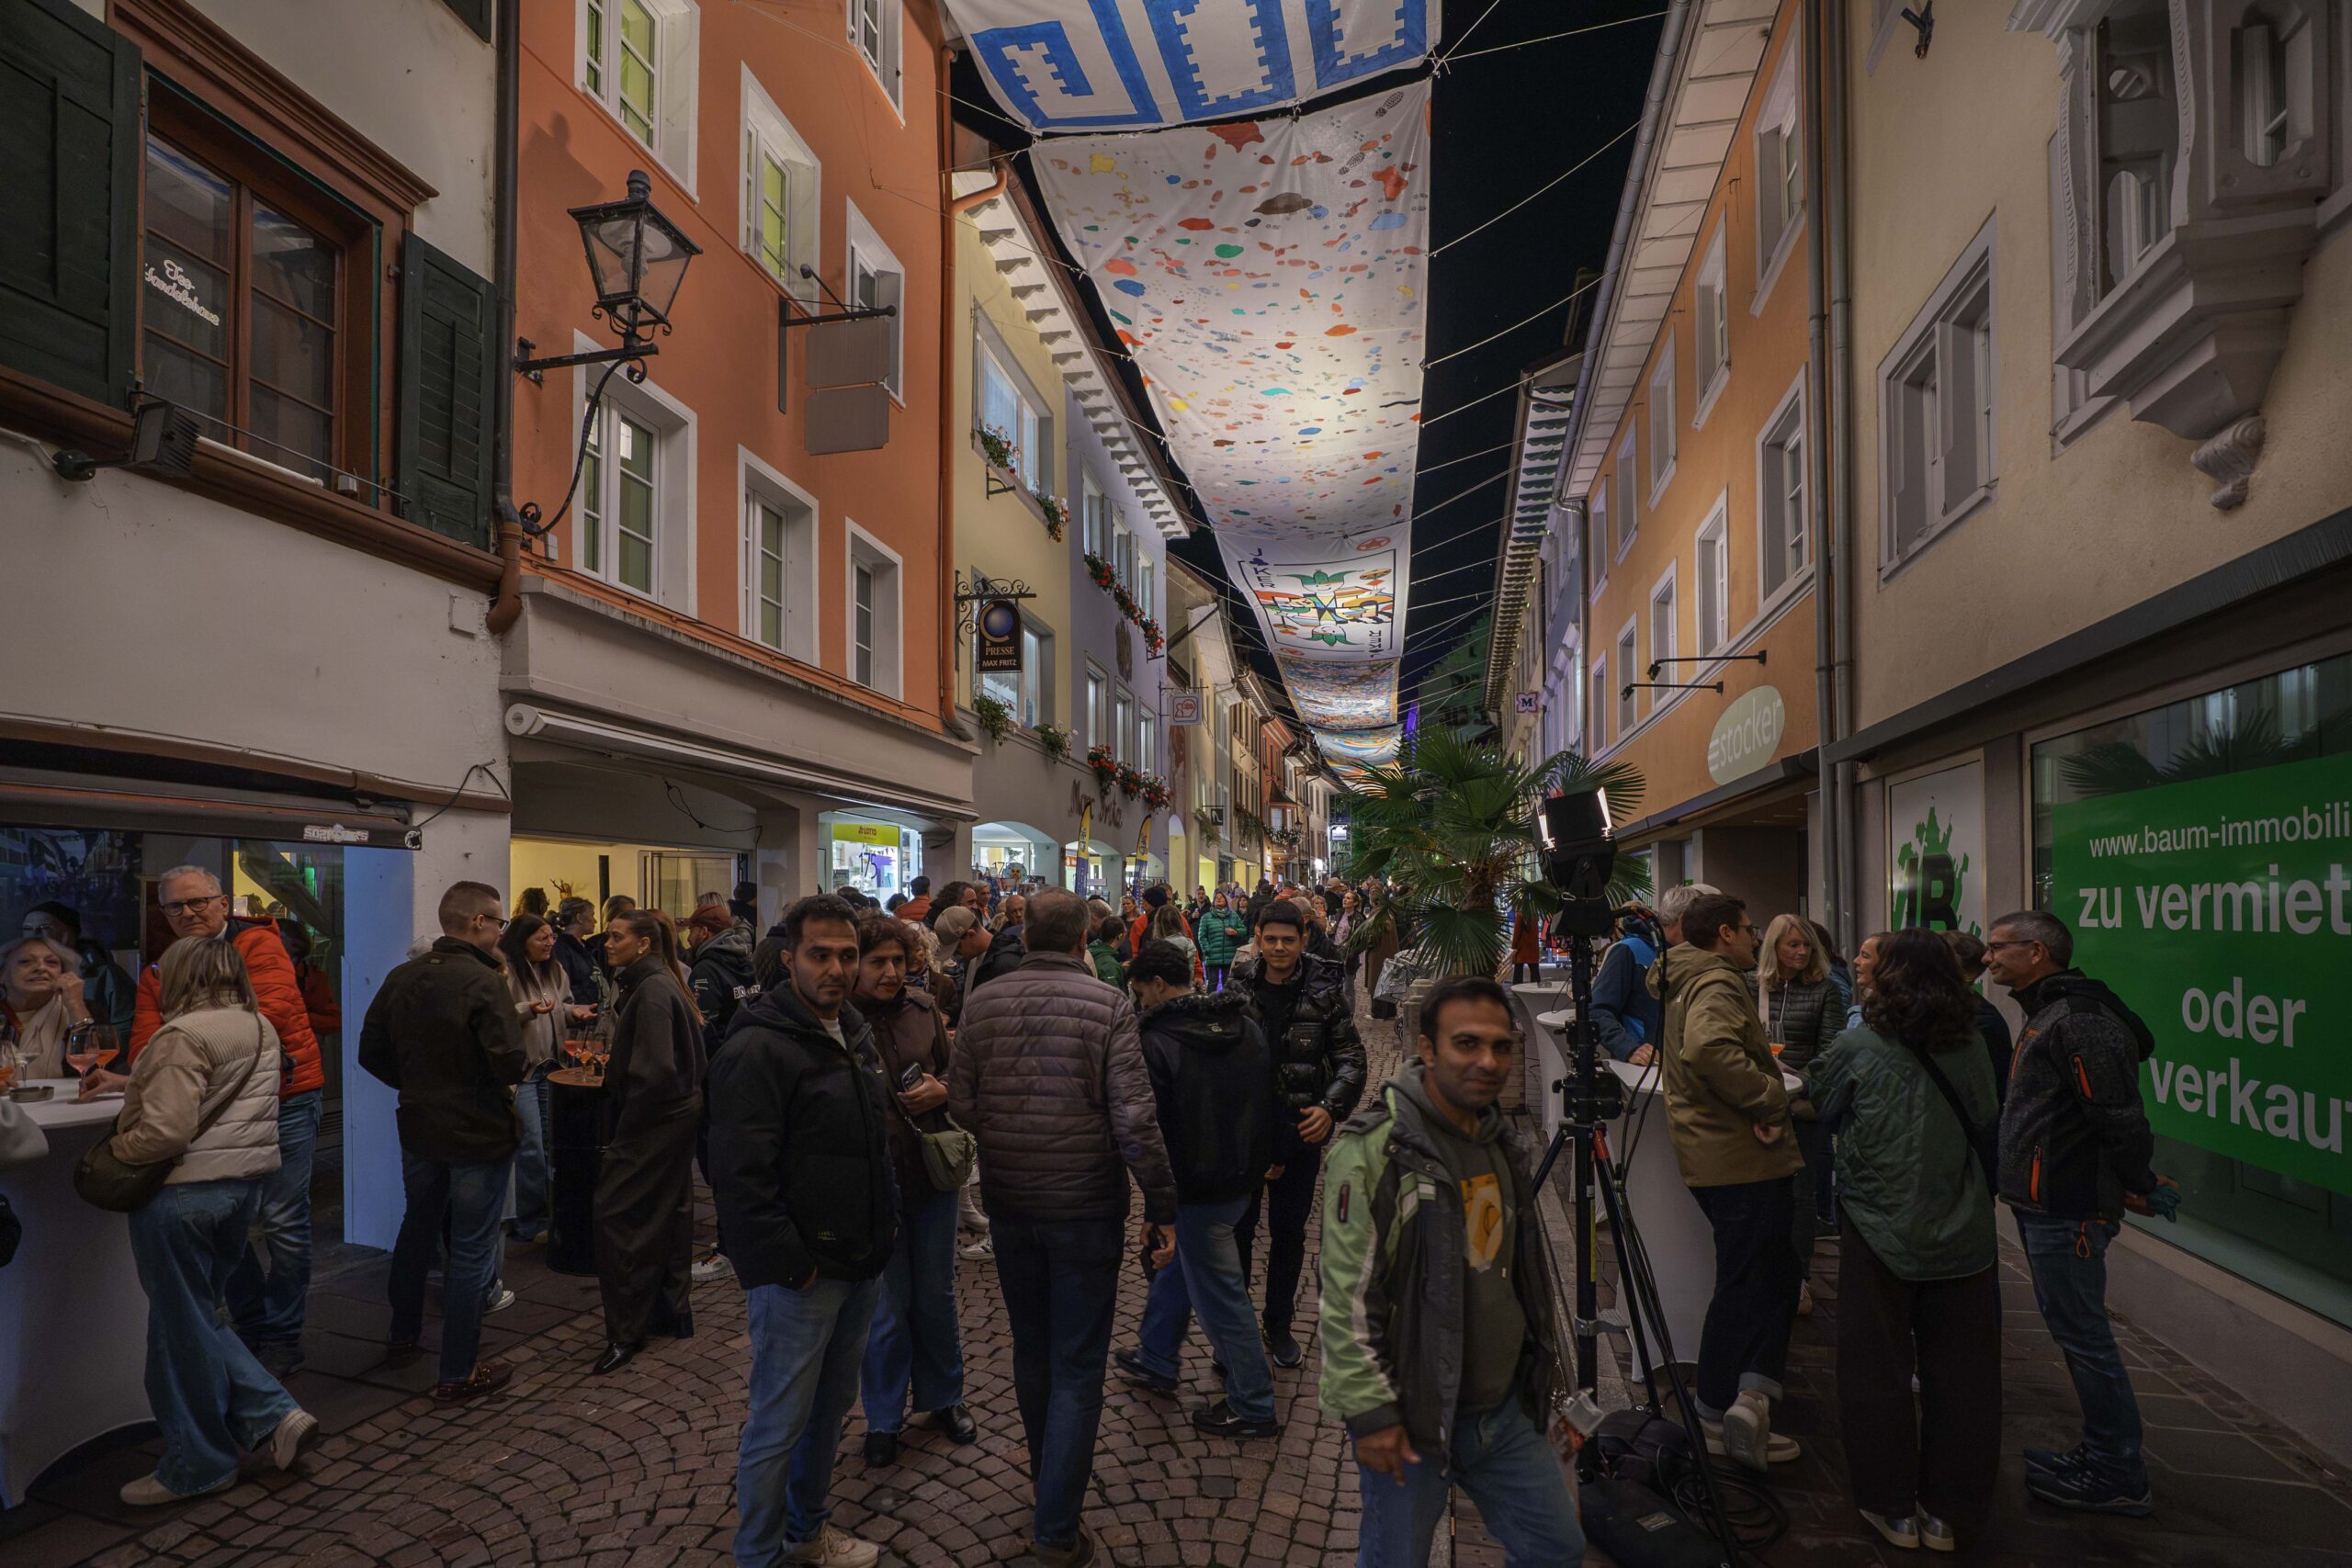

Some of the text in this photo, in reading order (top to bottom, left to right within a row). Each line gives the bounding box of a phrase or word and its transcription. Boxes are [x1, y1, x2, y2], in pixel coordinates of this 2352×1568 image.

[985, 646, 1015, 656] PRESSE
[982, 659, 1017, 668] MAX FRITZ
[1521, 697, 1532, 707] M
[864, 827, 877, 836] LOTTO
[2077, 886, 2123, 929] zu
[2180, 976, 2307, 1048] oder
[2148, 1056, 2352, 1155] verkau
